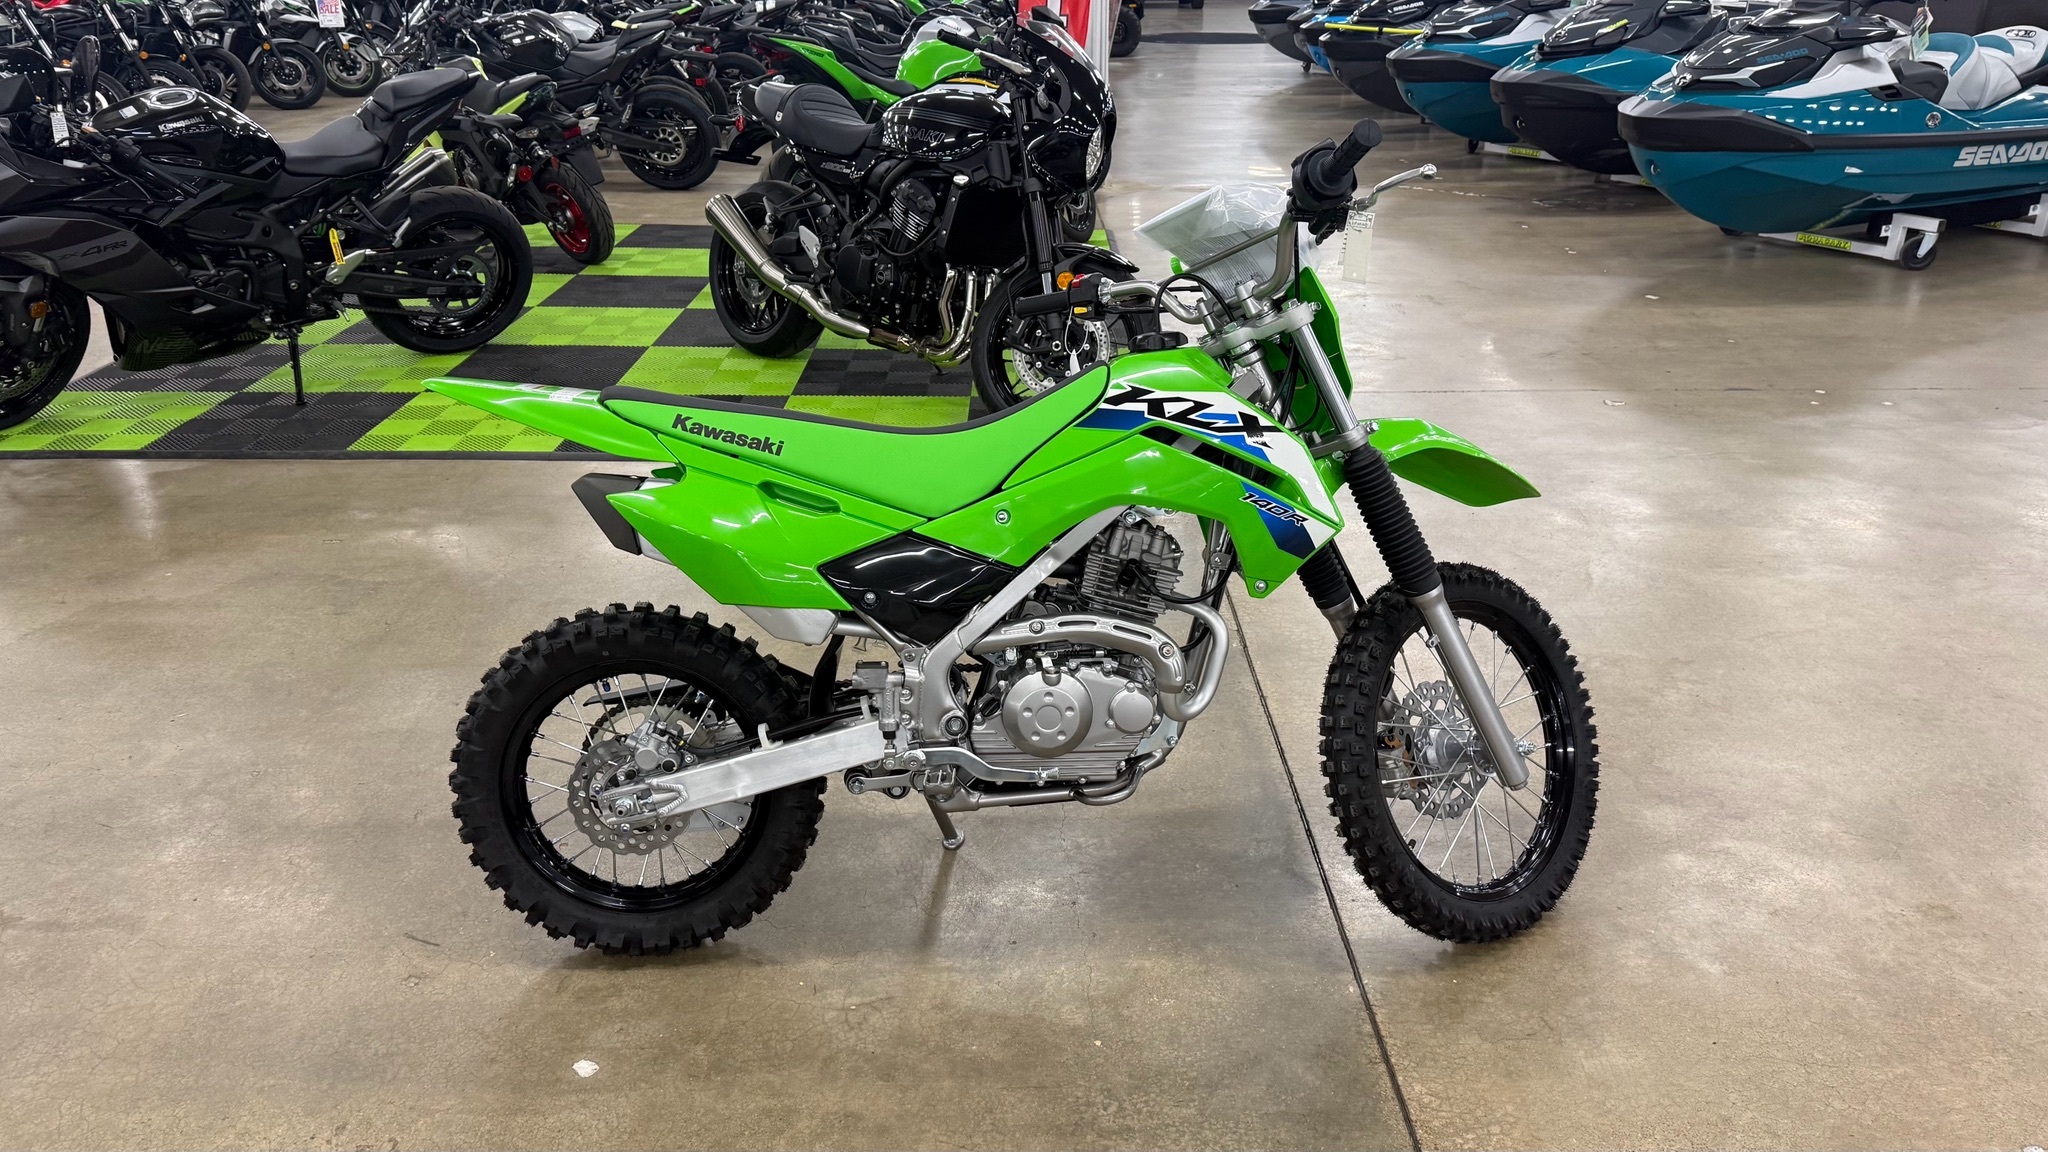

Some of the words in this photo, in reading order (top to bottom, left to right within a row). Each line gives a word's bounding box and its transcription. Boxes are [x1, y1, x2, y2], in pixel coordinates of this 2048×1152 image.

[319, 4, 340, 14] SALE
[158, 115, 205, 132] Kawasaki
[671, 413, 785, 457] Kawasaki
[1103, 384, 1286, 450] KLX
[1239, 491, 1310, 527] 140R
